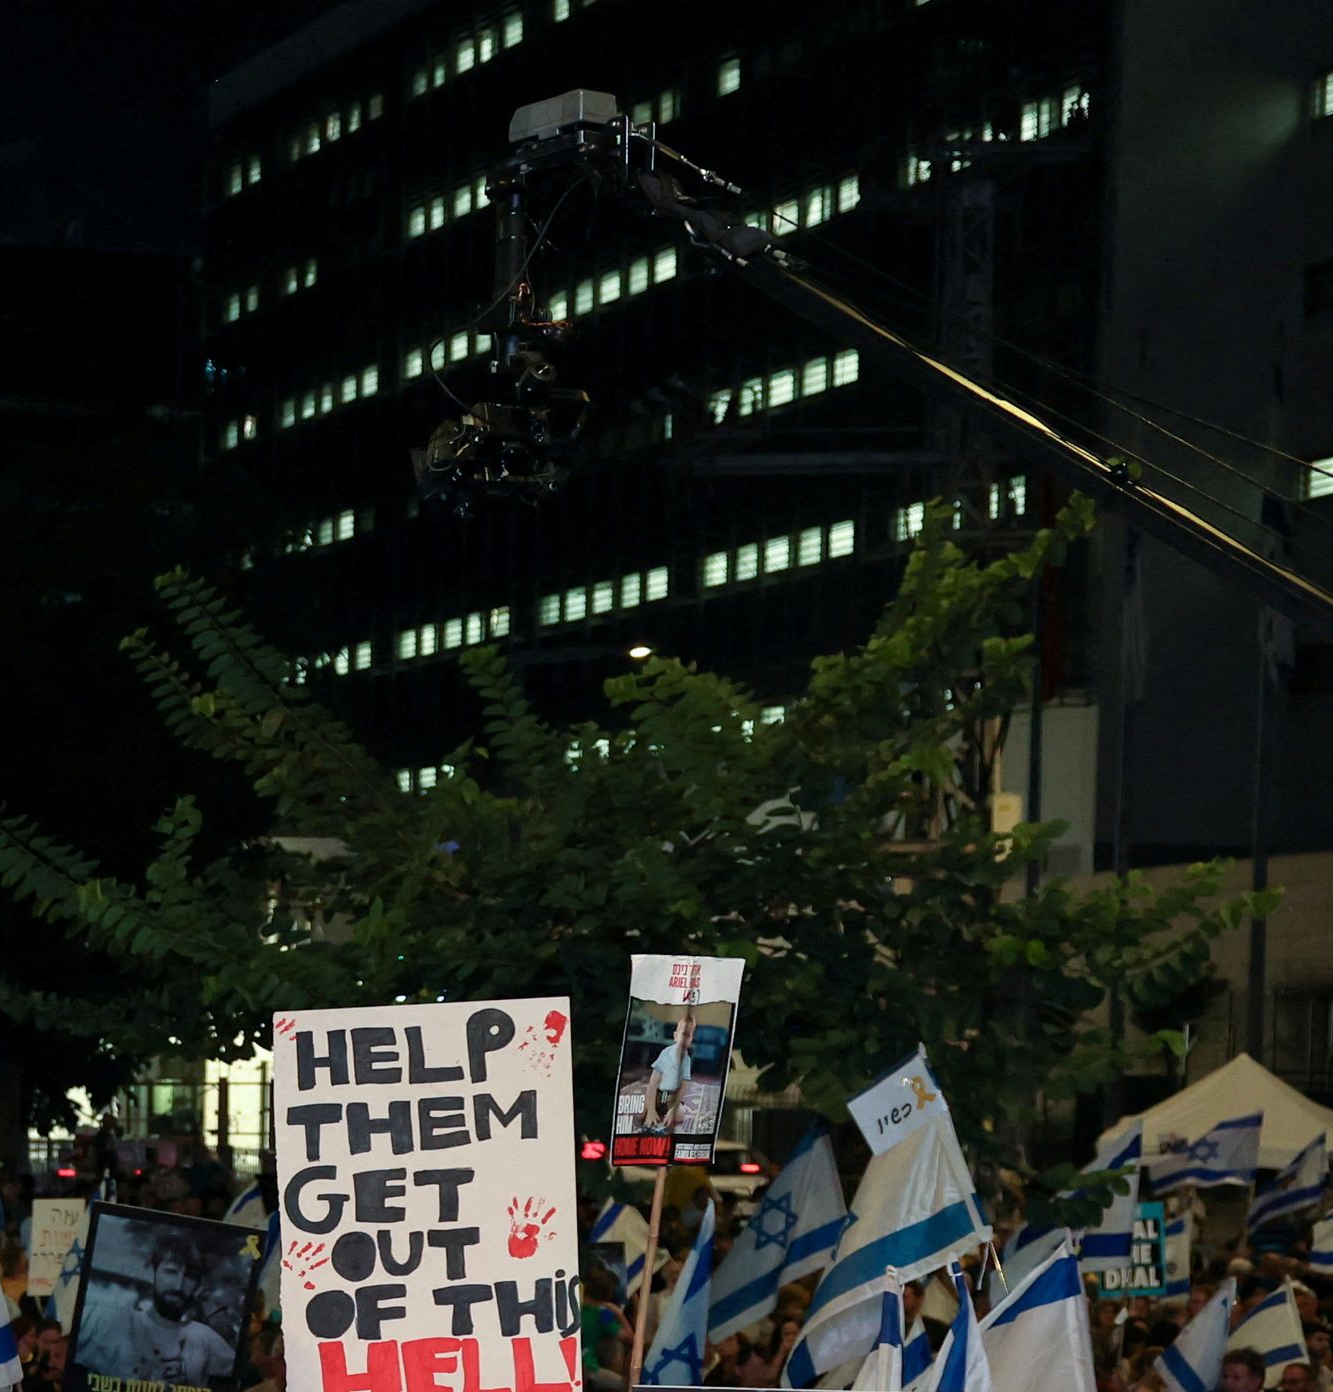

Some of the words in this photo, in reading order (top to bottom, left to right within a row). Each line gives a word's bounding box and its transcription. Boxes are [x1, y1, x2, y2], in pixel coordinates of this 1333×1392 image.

[295, 1007, 515, 1091] HELP
[287, 1089, 538, 1161] THEM
[616, 1115, 634, 1134] HIM
[618, 1094, 645, 1114] BRING
[283, 1165, 475, 1235] GET
[331, 1227, 480, 1282] OUT
[305, 1284, 408, 1340] OF
